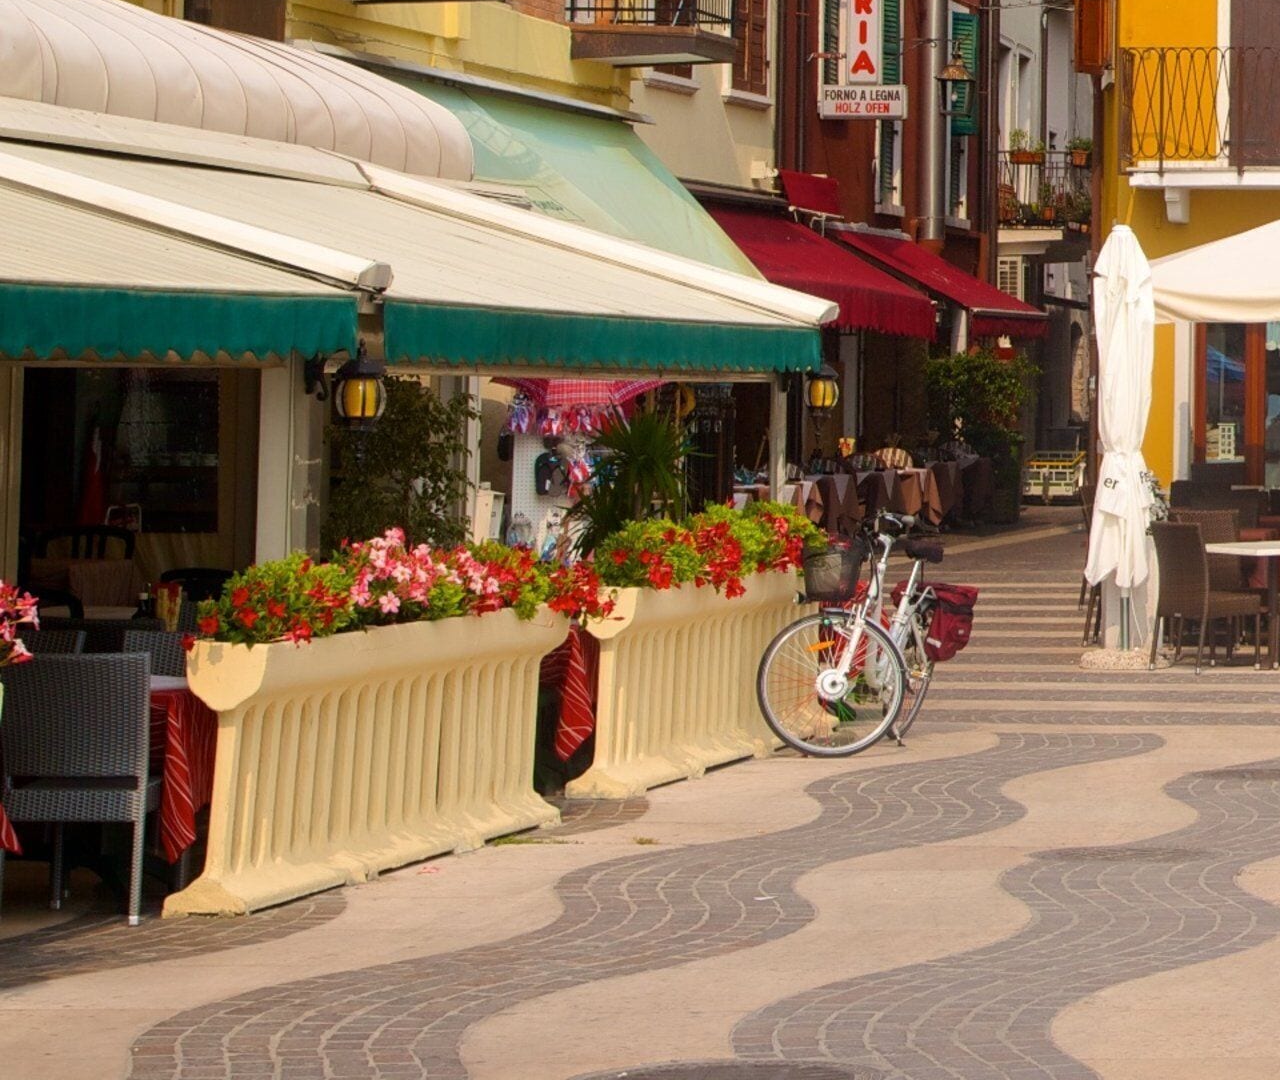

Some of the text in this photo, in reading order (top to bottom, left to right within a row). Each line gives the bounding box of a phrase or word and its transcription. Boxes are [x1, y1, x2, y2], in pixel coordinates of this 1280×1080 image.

[824, 89, 901, 102] FORNO A LEGNA
[835, 102, 890, 114] HOLZ OFEN
